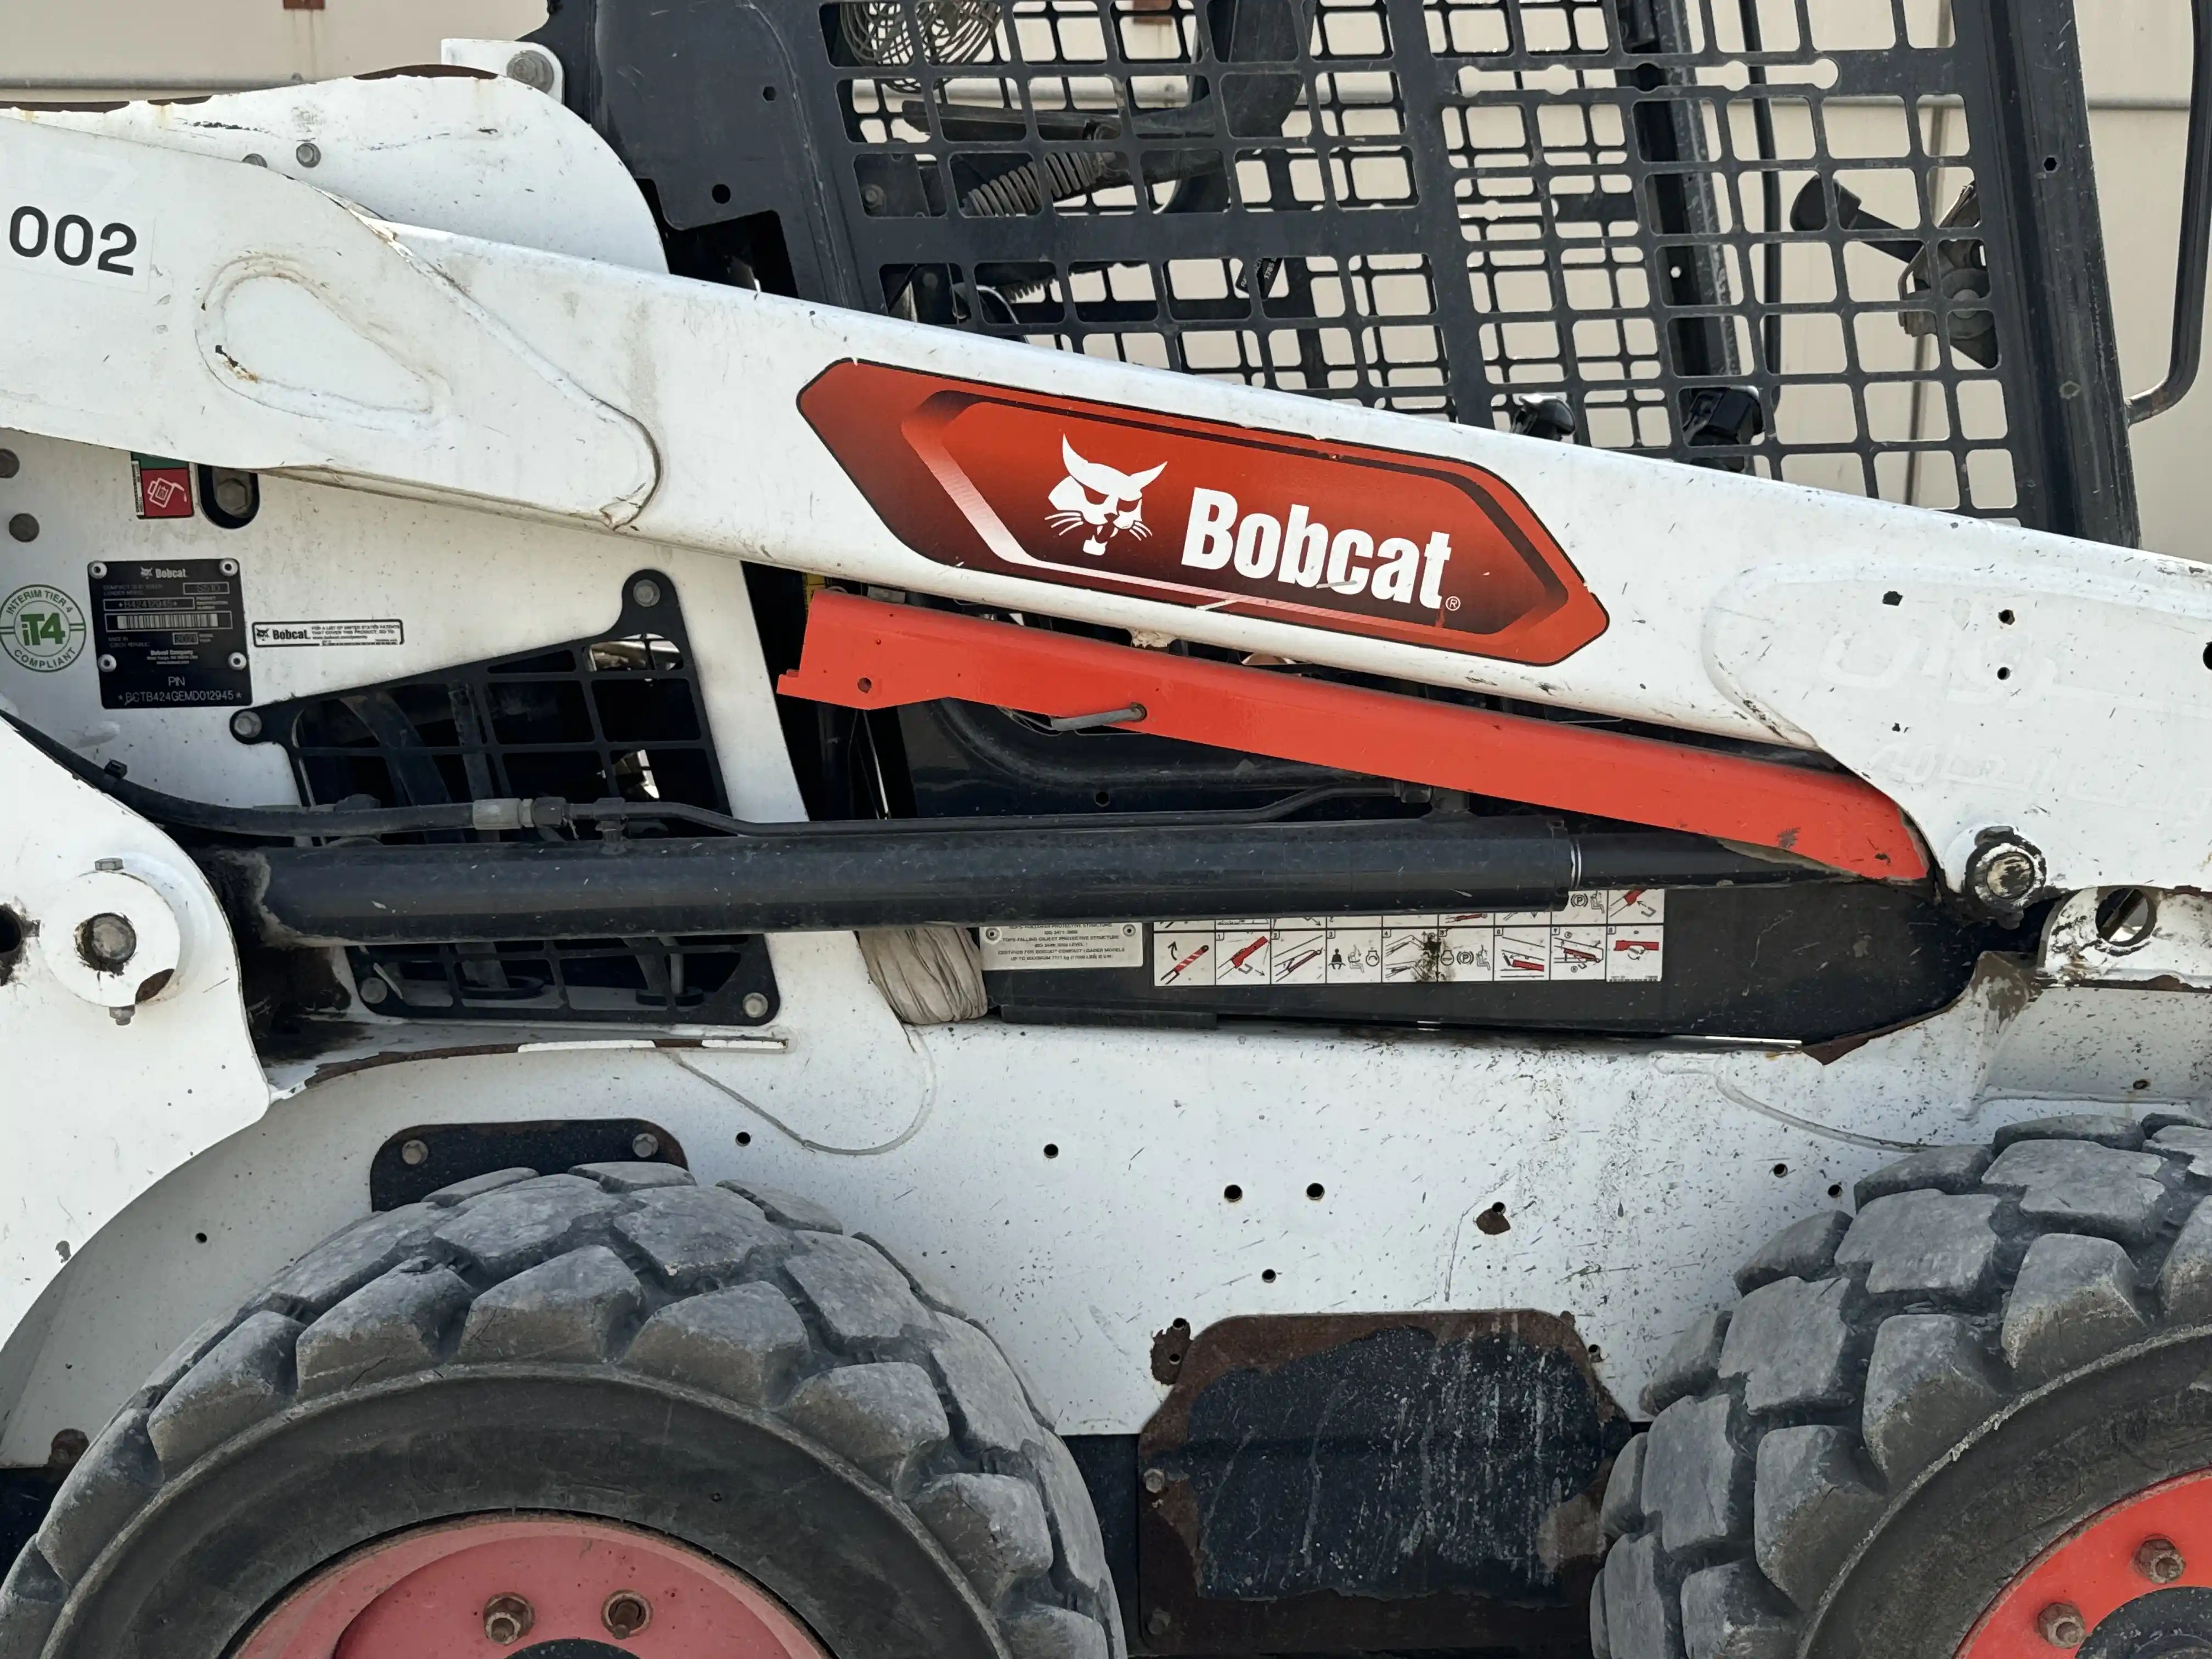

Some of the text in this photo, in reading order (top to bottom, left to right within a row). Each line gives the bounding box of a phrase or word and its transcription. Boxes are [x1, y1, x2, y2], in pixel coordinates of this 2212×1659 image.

[9, 205, 137, 276] 002
[155, 568, 187, 578] Bobcat
[6, 590, 42, 615] INTERIM
[44, 590, 66, 607] TIER
[20, 612, 66, 646] iT4
[273, 629, 311, 640] Bobcat
[14, 647, 76, 668] COMPLIANT
[168, 676, 185, 686] PIN
